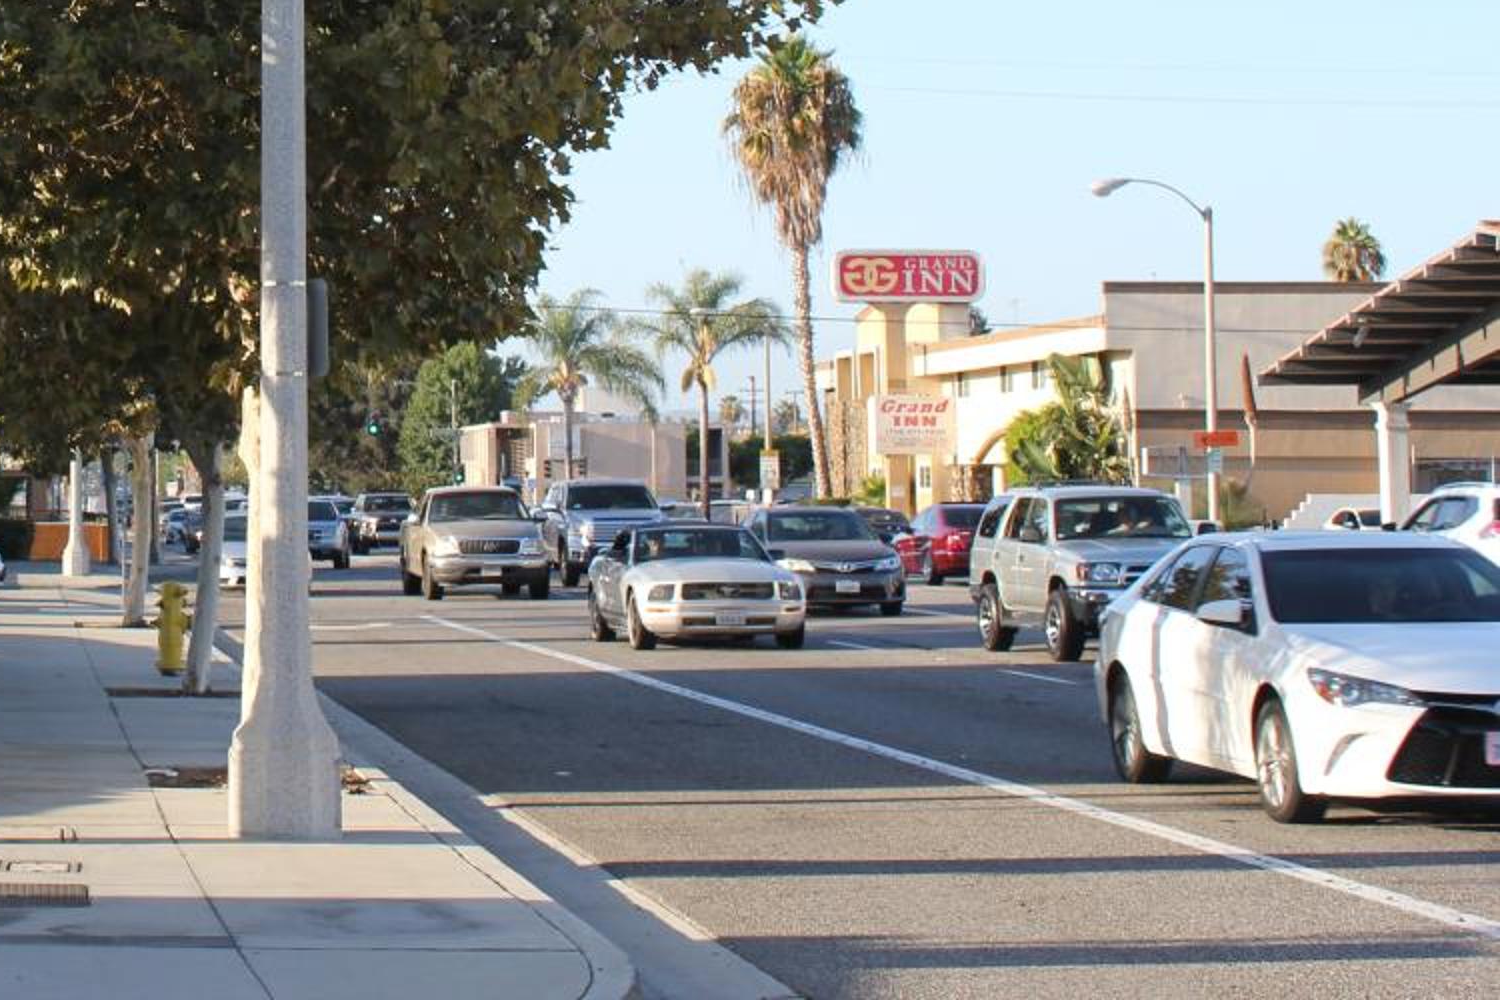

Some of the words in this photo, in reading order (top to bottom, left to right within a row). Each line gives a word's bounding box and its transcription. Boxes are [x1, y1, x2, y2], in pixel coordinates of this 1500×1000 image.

[904, 257, 972, 269] GRAND
[902, 270, 974, 293] INN
[881, 399, 949, 413] Grand
[893, 416, 937, 427] INN
